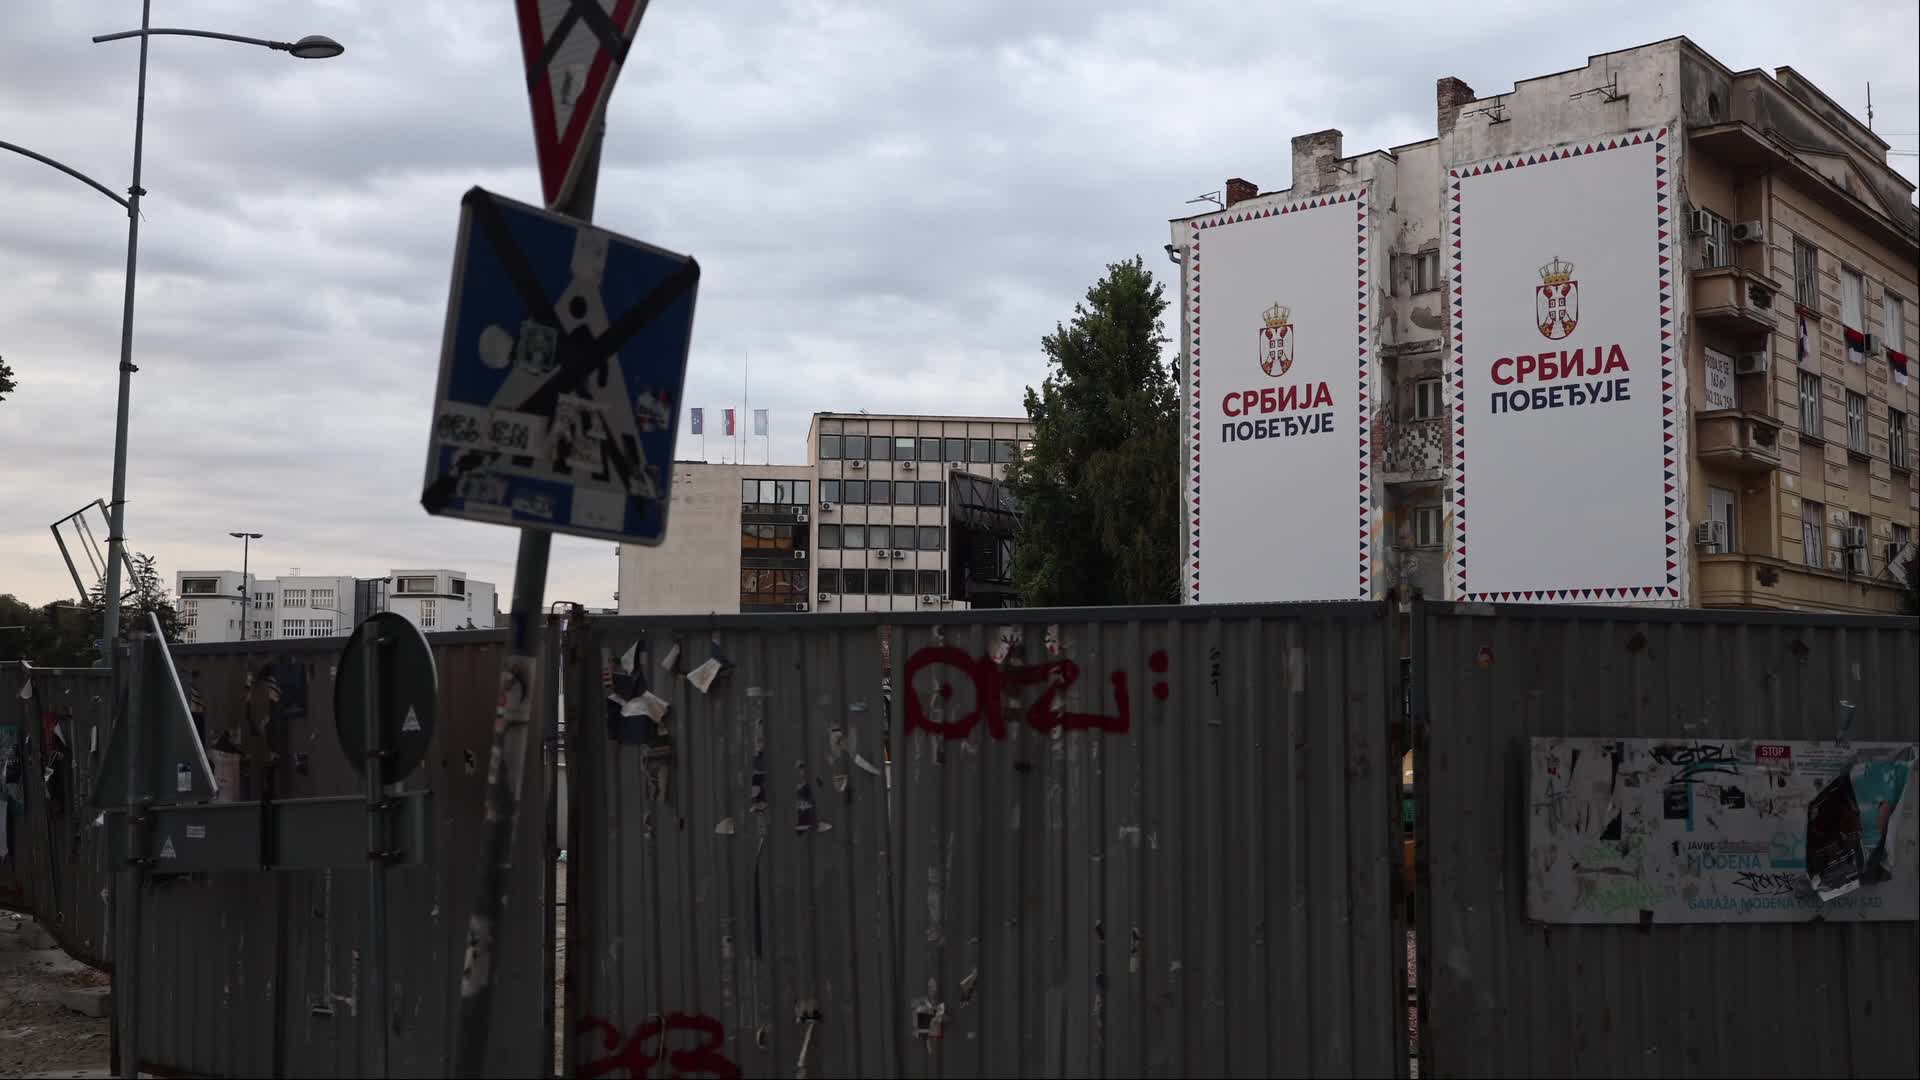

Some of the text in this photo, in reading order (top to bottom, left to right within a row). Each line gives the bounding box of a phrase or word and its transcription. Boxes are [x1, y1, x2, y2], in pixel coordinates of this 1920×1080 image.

[1490, 344, 1630, 386] СРБИЈА
[1222, 381, 1334, 417] СРБИЈА
[1491, 378, 1631, 414] ПОБЕЂУЈЕ
[1222, 412, 1334, 443] ПОБЕЂУЈЕ
[1761, 746, 1785, 757] STOP
